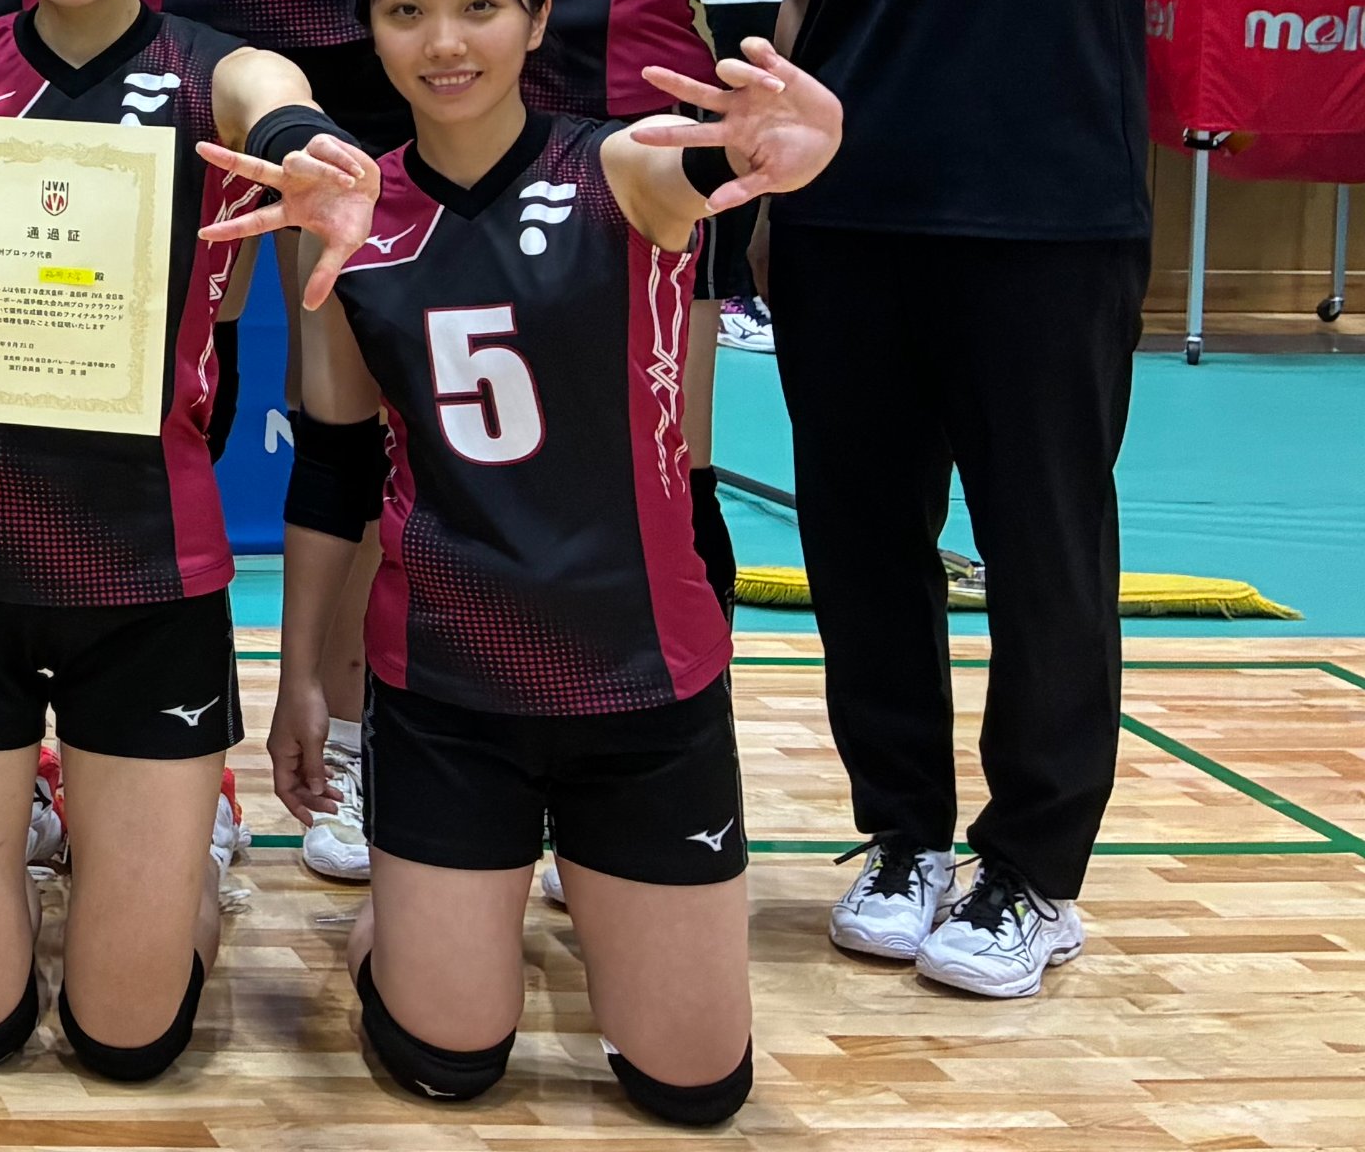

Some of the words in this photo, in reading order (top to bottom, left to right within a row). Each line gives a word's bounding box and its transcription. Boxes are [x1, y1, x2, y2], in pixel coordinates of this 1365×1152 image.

[1245, 5, 1365, 53] mol
[45, 181, 65, 192] JVA
[423, 302, 547, 465] 5
